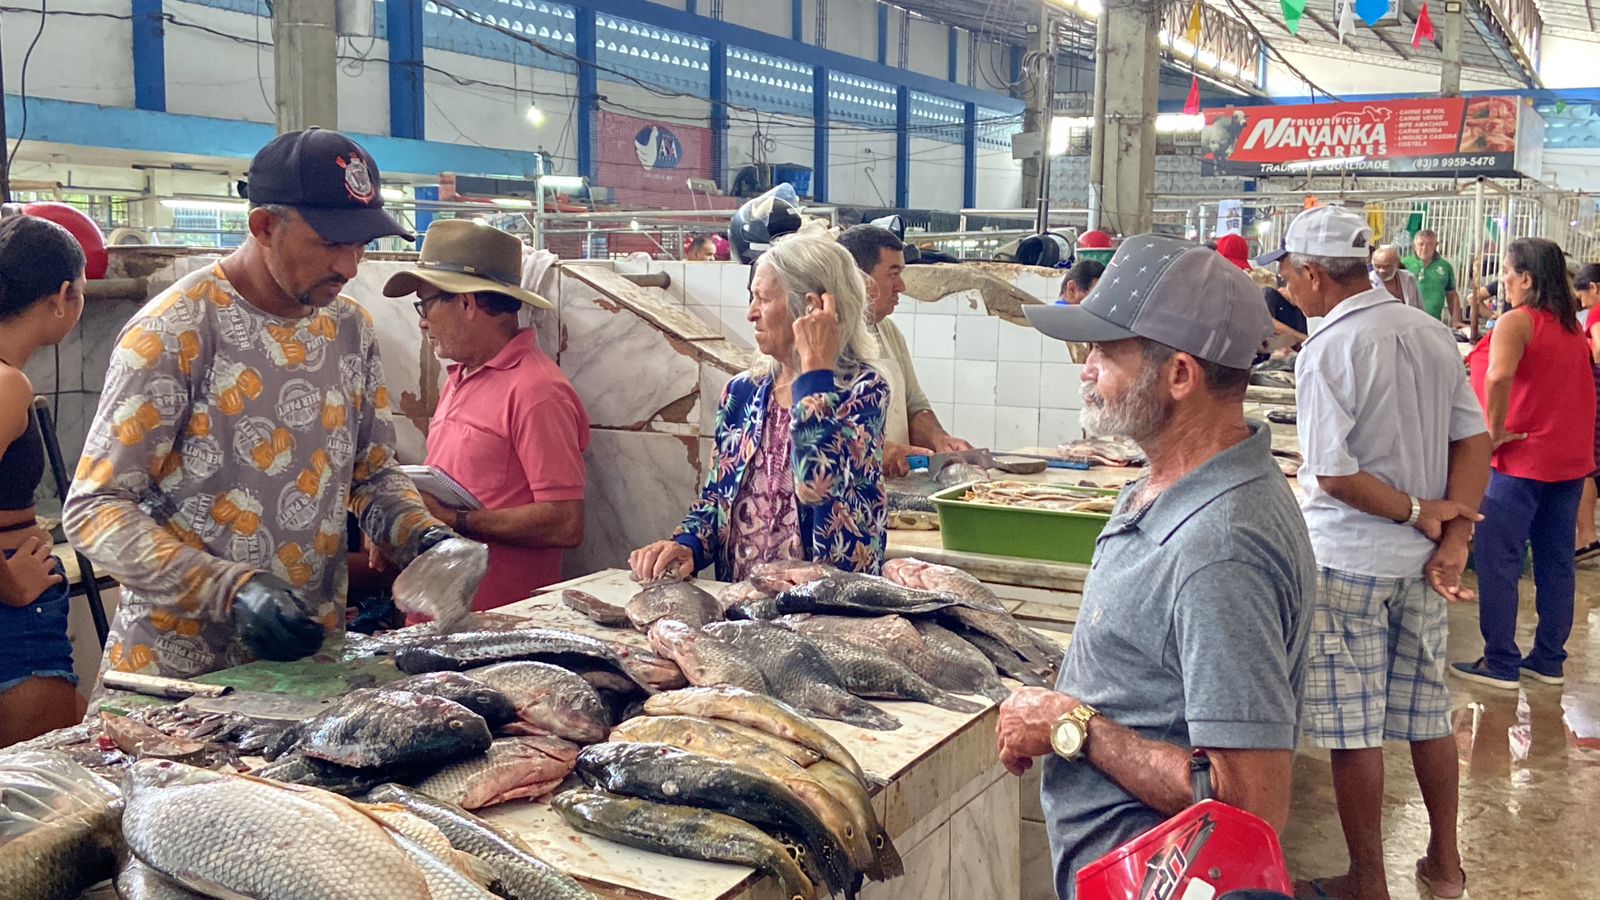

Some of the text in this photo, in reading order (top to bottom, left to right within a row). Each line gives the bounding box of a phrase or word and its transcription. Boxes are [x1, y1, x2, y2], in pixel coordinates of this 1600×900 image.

[1242, 117, 1387, 150] NANANKA
[1307, 144, 1387, 158] CARNES
[1412, 156, 1496, 169] (83)9 9959-5476
[234, 323, 250, 348] BEER
